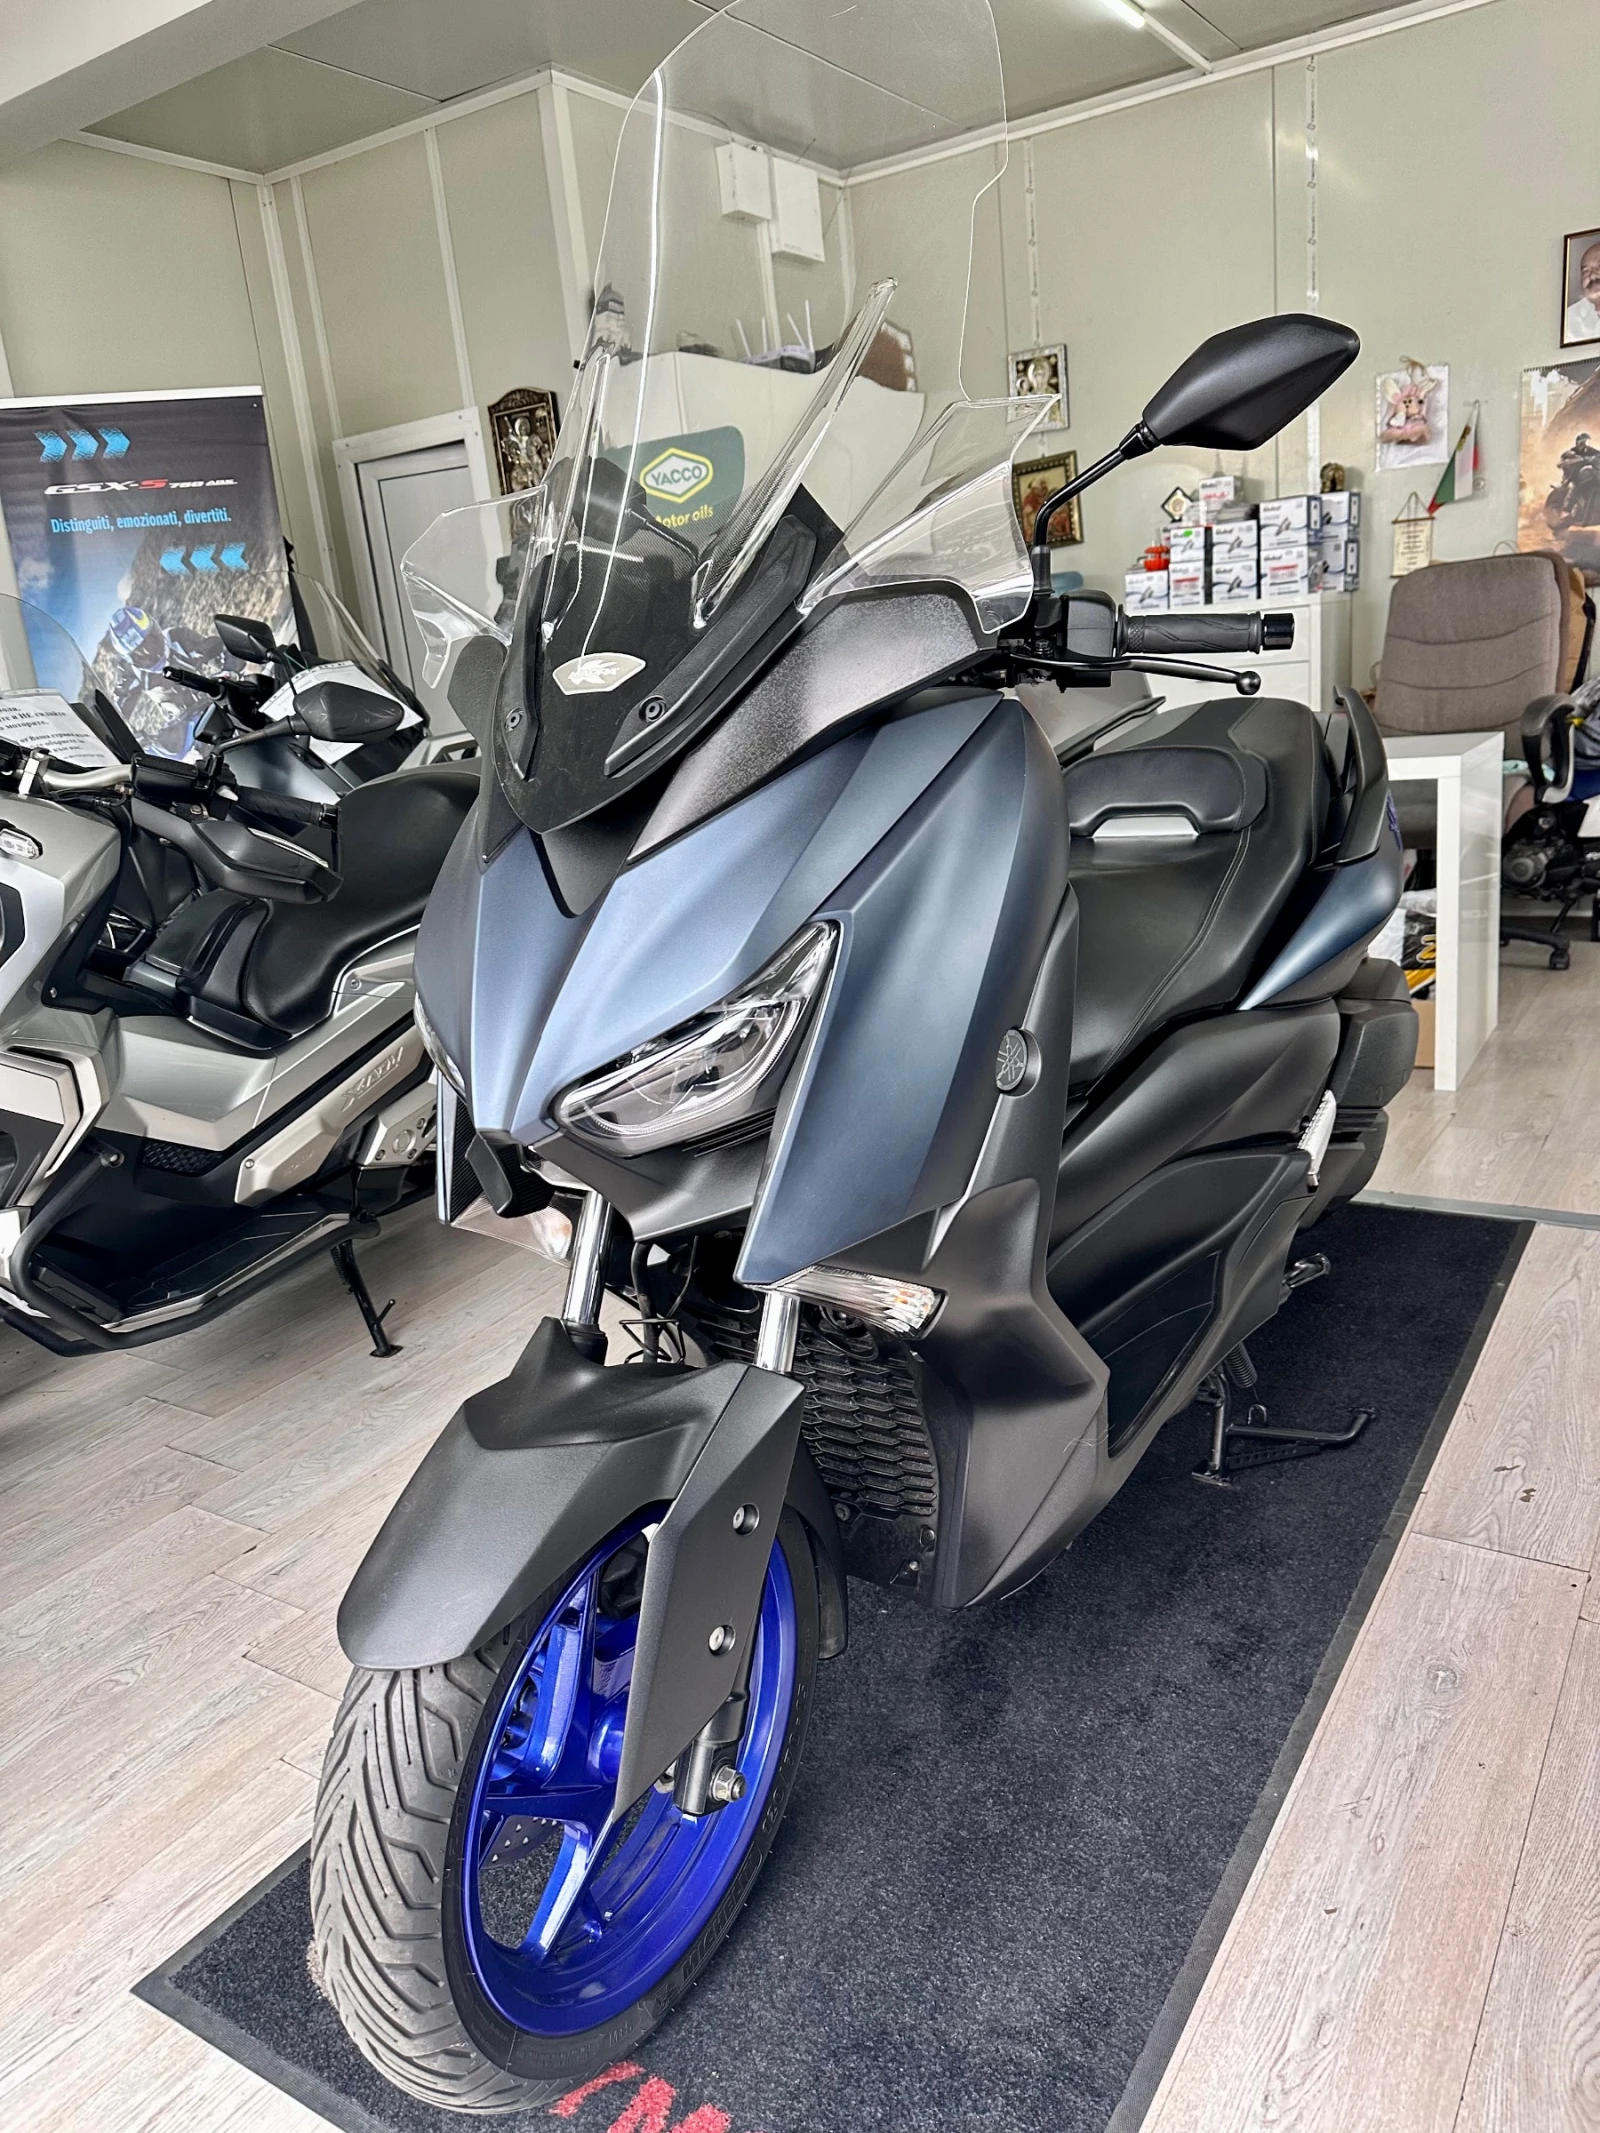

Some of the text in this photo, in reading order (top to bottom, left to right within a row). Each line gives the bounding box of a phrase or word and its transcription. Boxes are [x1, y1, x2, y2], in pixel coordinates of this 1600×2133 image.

[651, 466, 702, 486] YACCO
[50, 507, 232, 534] Distinguiti, emozionati, divertiti.
[692, 504, 714, 522] oils
